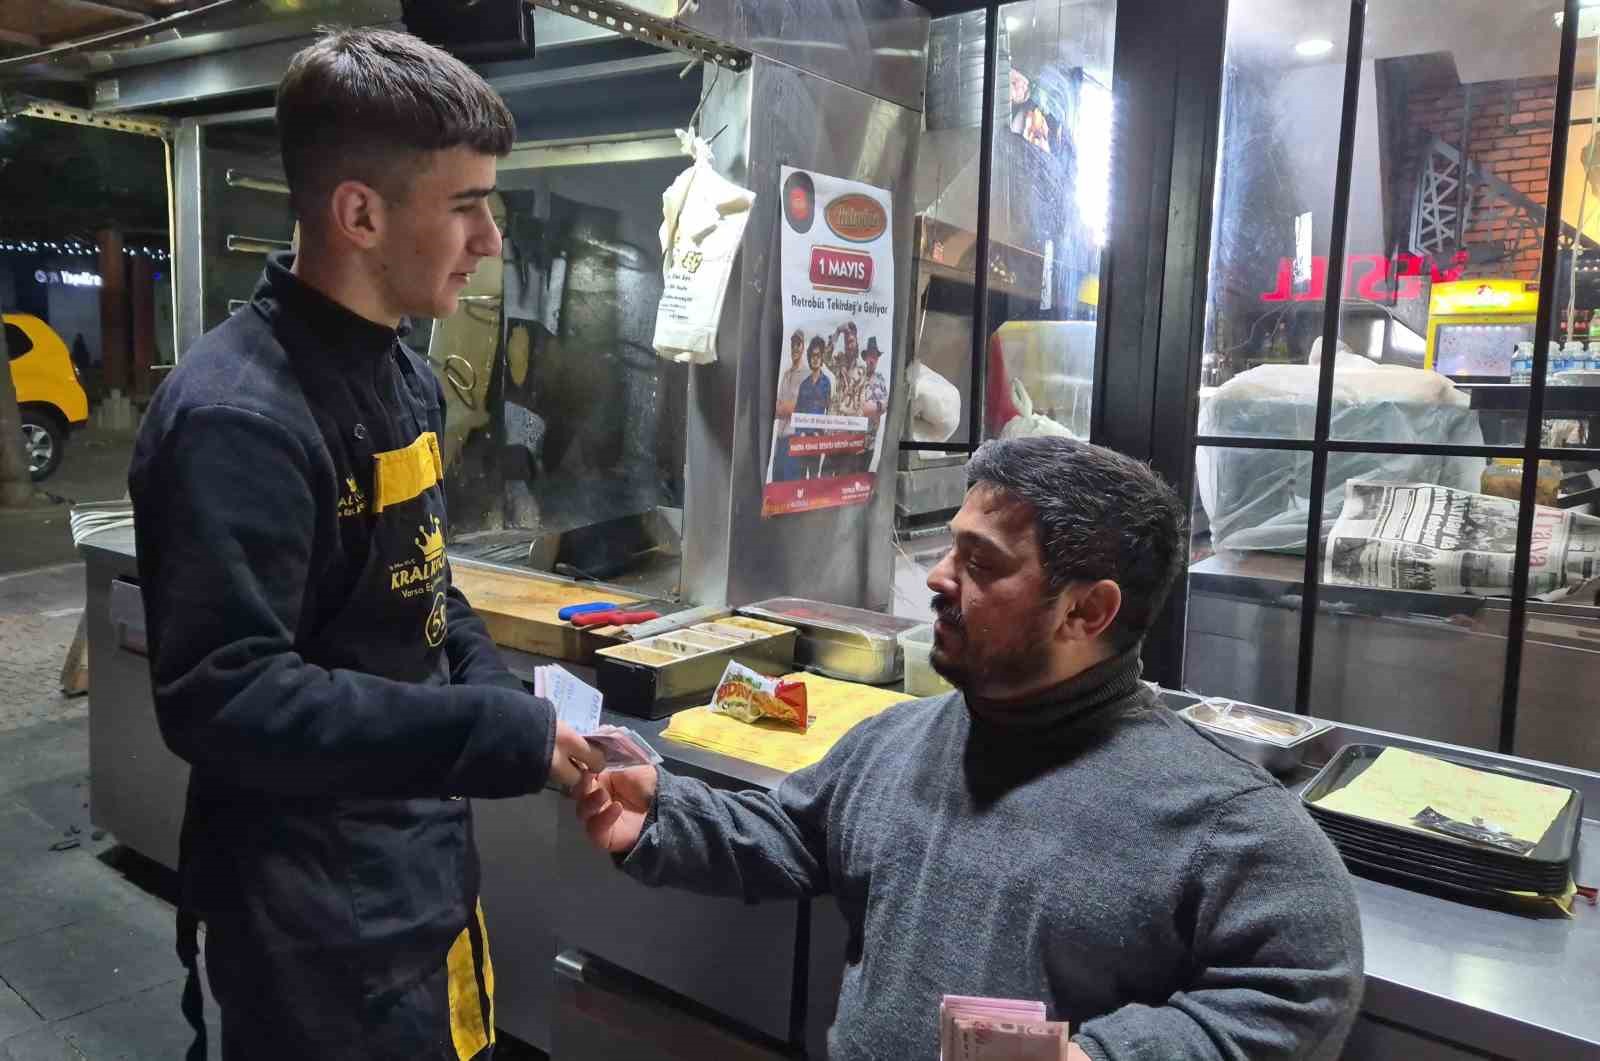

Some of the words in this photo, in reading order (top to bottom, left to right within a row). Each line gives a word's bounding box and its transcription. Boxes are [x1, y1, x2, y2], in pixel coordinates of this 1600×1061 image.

[818, 258, 825, 275] 1
[829, 259, 865, 280] MAYIS
[791, 294, 825, 309] Retrobüs
[827, 298, 862, 316] Tekirdağ'a
[863, 301, 888, 317] Geliyor
